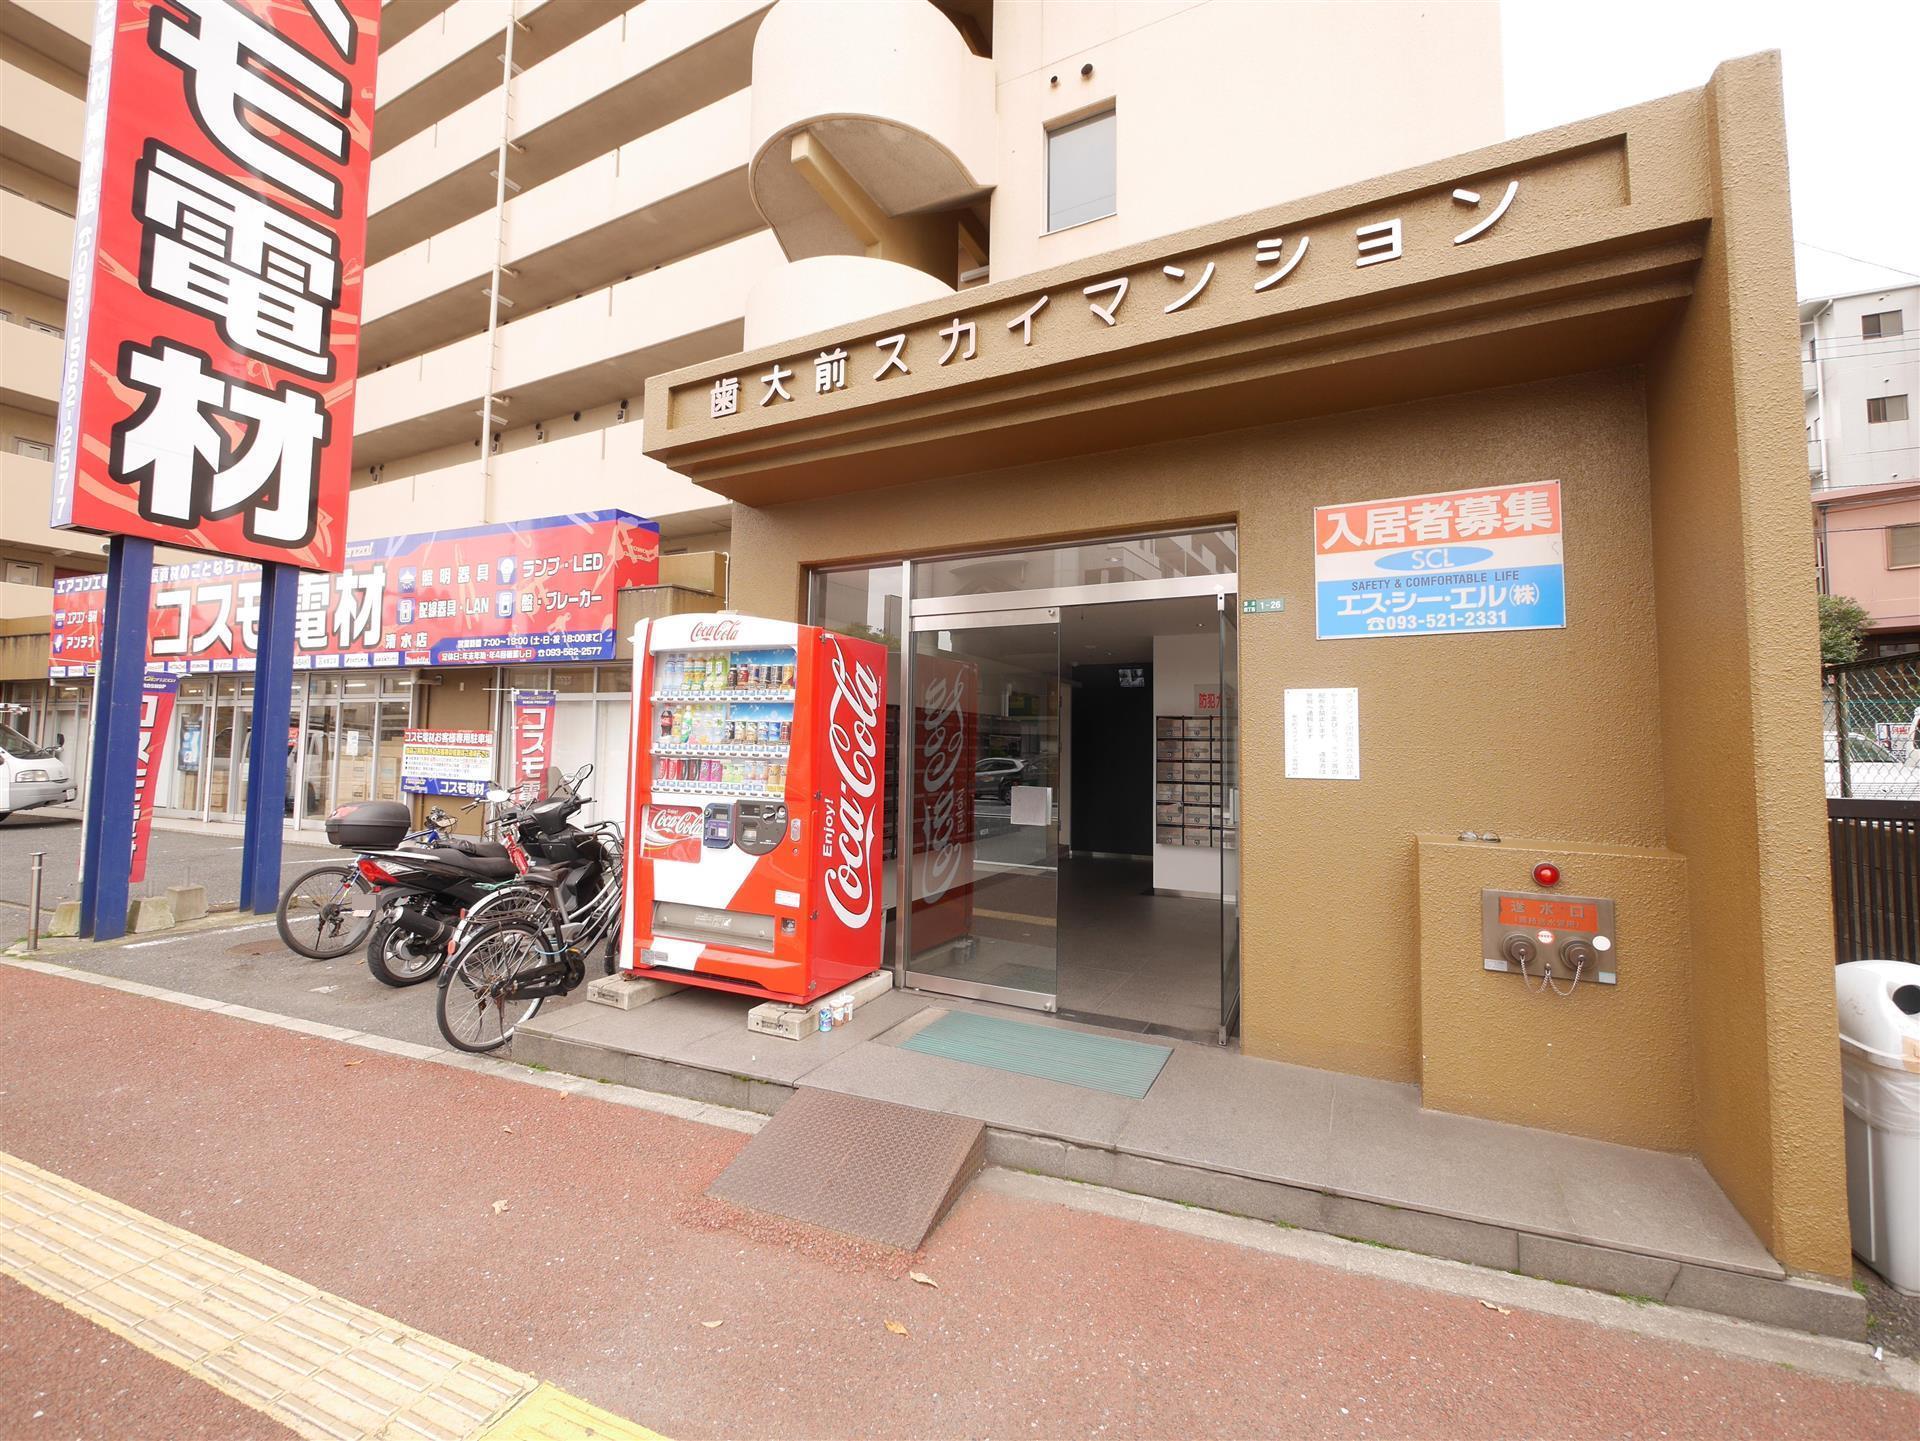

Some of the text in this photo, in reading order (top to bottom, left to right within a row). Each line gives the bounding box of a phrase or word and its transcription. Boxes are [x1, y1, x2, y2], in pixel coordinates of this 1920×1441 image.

[118, 0, 352, 543] モ電材
[709, 180, 1519, 418] 歯大前スカイマンション
[1322, 490, 1553, 549] 入居者募集
[522, 553, 604, 579] ランプ・LED
[1411, 547, 1455, 570] SCL
[421, 563, 490, 587] 照明器具
[1351, 570, 1520, 591] SAFETY & COMFORTABLE LIFE
[418, 597, 489, 620] 配線器具・LAN
[521, 588, 603, 613] 盤・ブレーカー
[1260, 600, 1281, 609] 1-26
[690, 620, 742, 642] Coca-Cola
[1386, 609, 1508, 631] 093-521-2331
[65, 635, 96, 650] アンテナ
[384, 632, 428, 649] 清水店
[440, 781, 485, 796] コスモ電材
[825, 634, 881, 929] Coca-Cola
[823, 797, 836, 858] Enjoy!
[1510, 901, 1585, 920] 送水口
